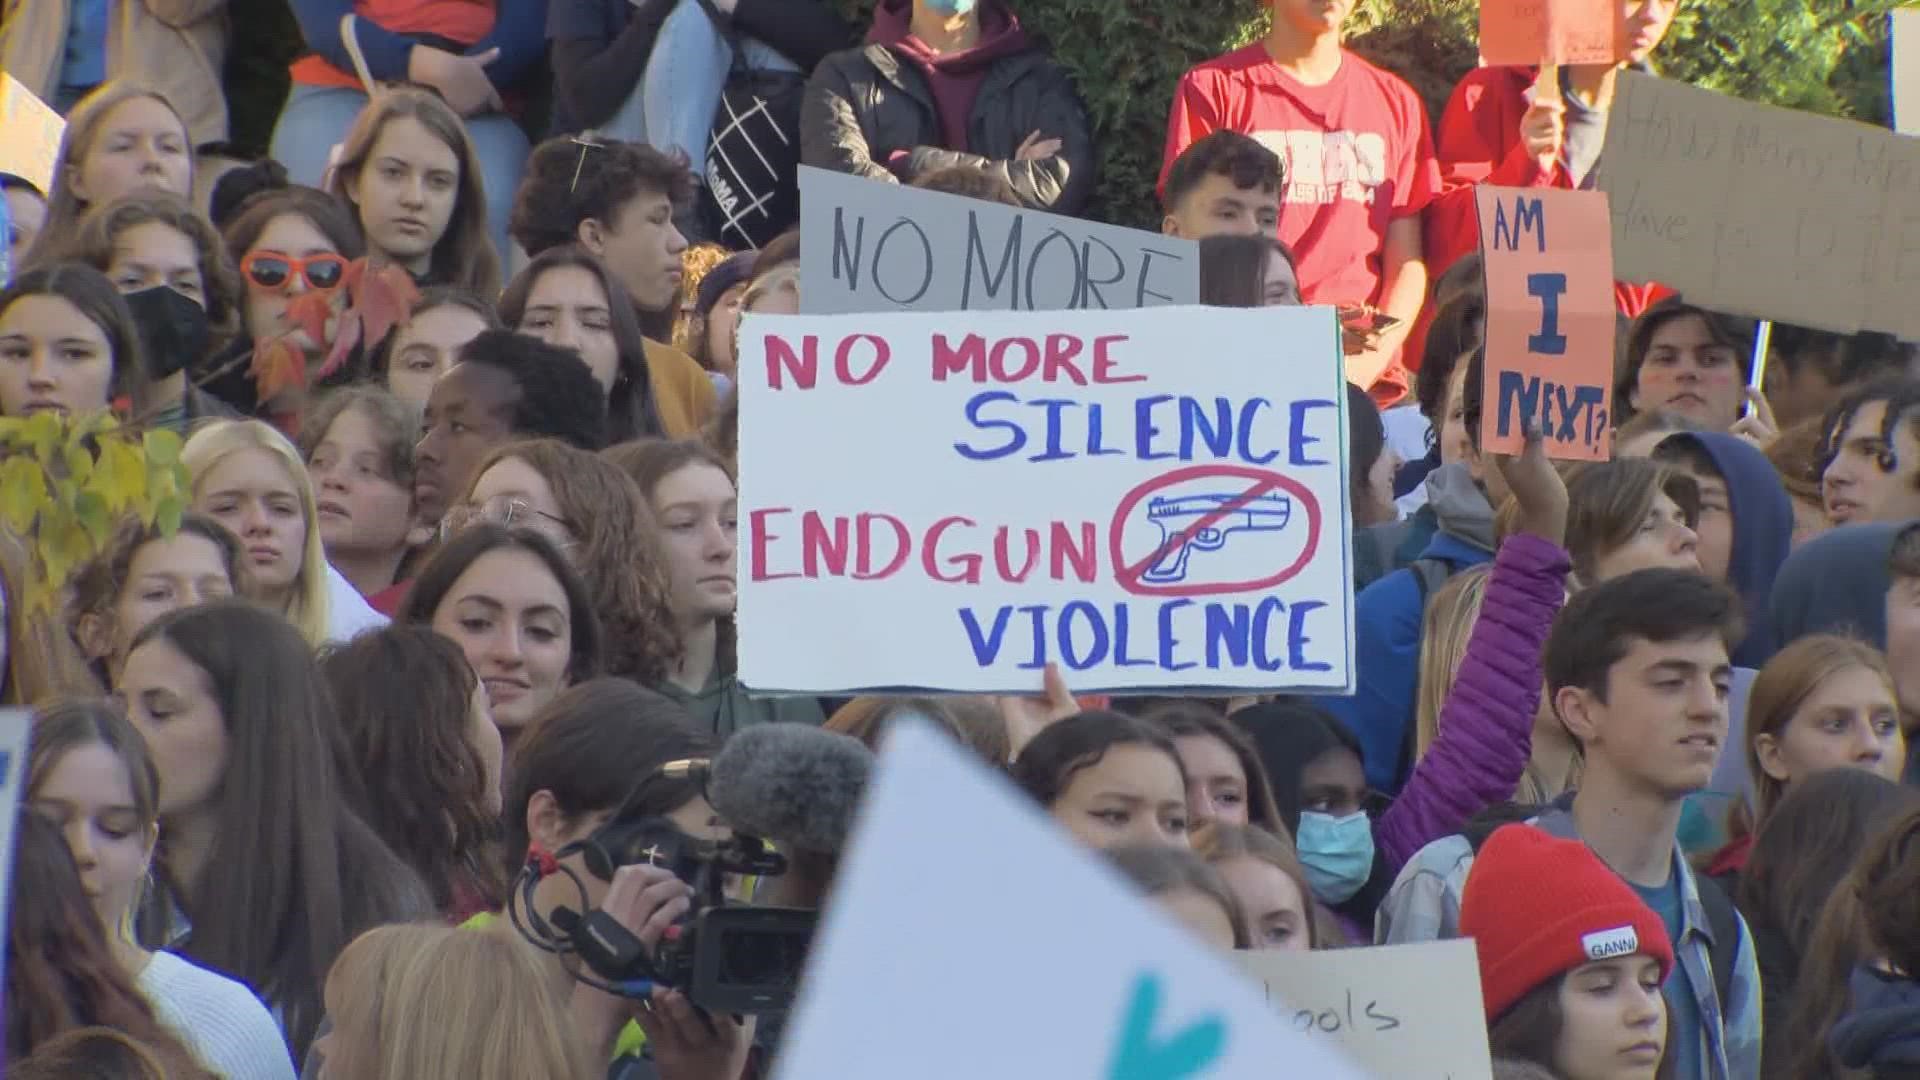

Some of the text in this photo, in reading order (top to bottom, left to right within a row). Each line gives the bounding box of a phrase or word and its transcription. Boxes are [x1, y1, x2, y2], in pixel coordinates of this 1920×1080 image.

[833, 206, 1184, 311] NO MORE
[1494, 196, 1545, 253] AM
[1527, 273, 1567, 355] I
[764, 333, 1148, 390] NO MORE
[953, 391, 1336, 465] SILENCE
[1497, 370, 1607, 455] NEXT?
[958, 596, 1333, 671] VIOLENCE
[1591, 936, 1635, 956] GANNI
